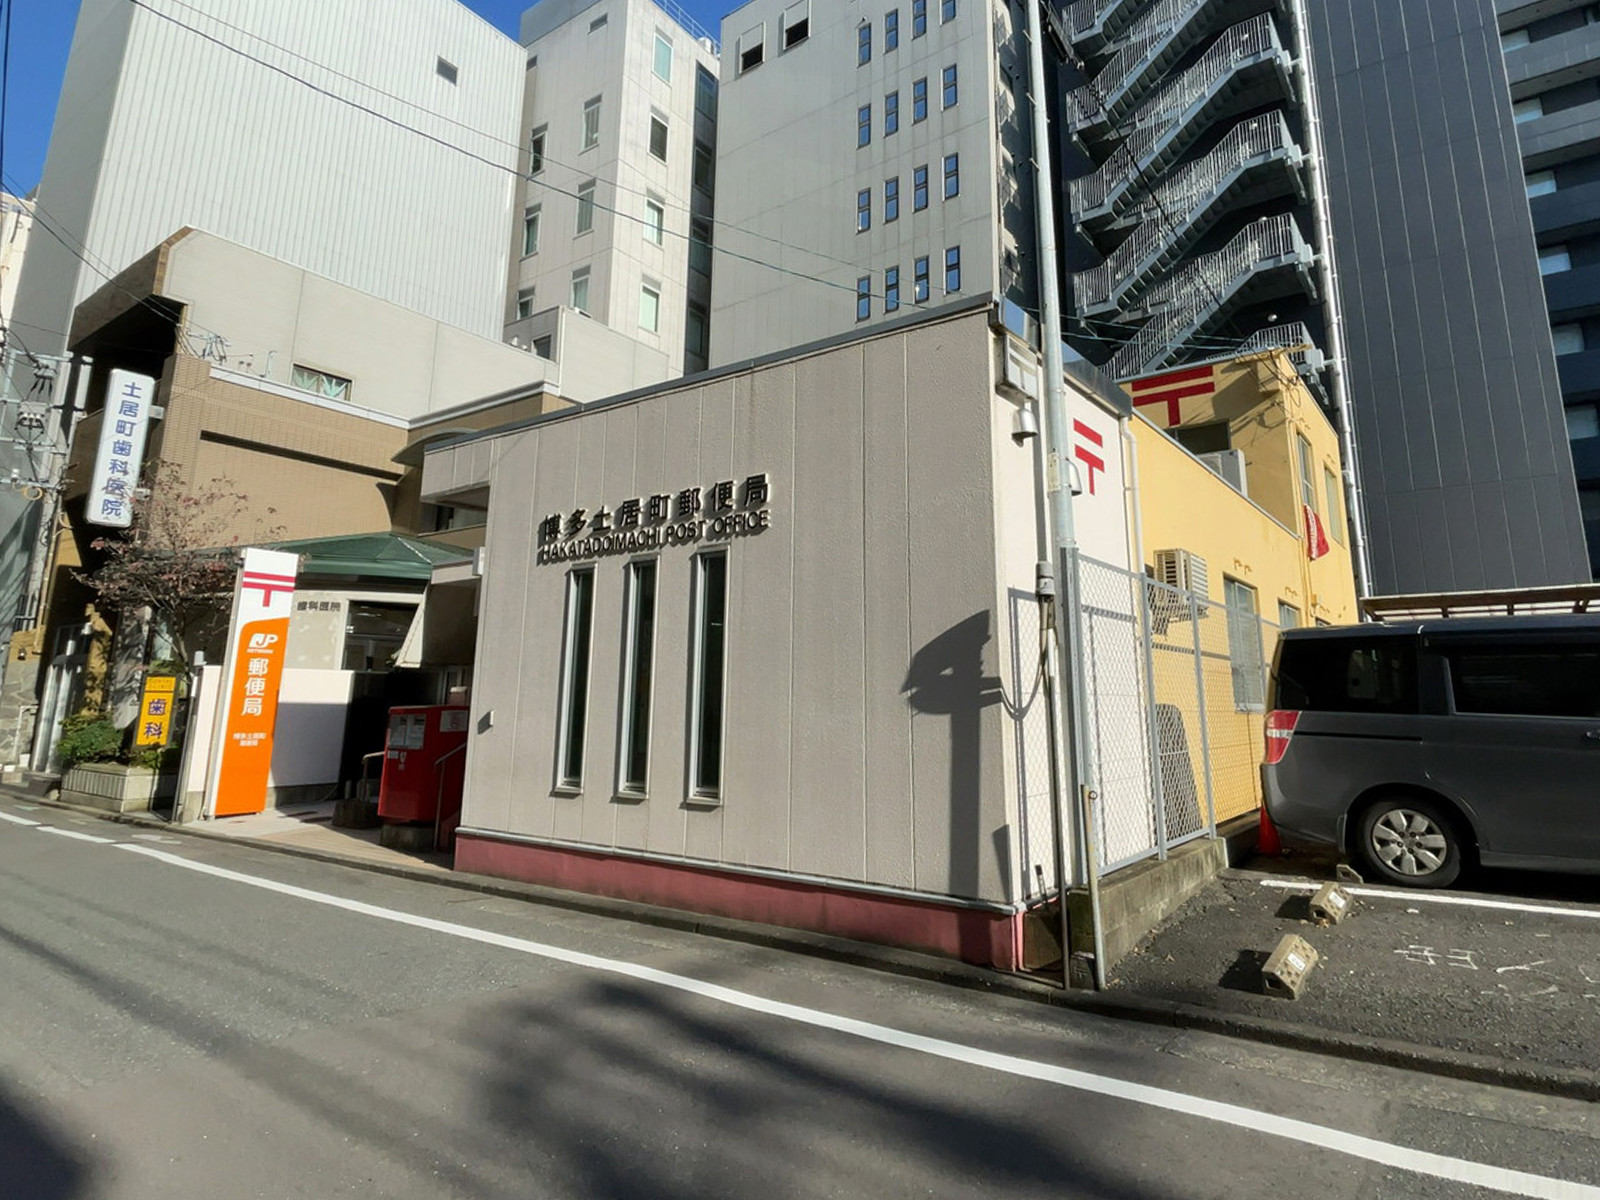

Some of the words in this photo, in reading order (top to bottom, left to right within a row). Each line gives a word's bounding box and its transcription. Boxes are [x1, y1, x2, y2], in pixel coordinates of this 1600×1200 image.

[101, 381, 142, 516] 土居町歯科医院
[541, 530, 661, 561] HAKATADOIMACHI
[666, 519, 706, 543] POST
[713, 509, 770, 535] OFFICE
[543, 473, 769, 541] 博多土居町郵便局
[241, 658, 269, 716] 郵便局
[144, 698, 167, 739] 歯科
